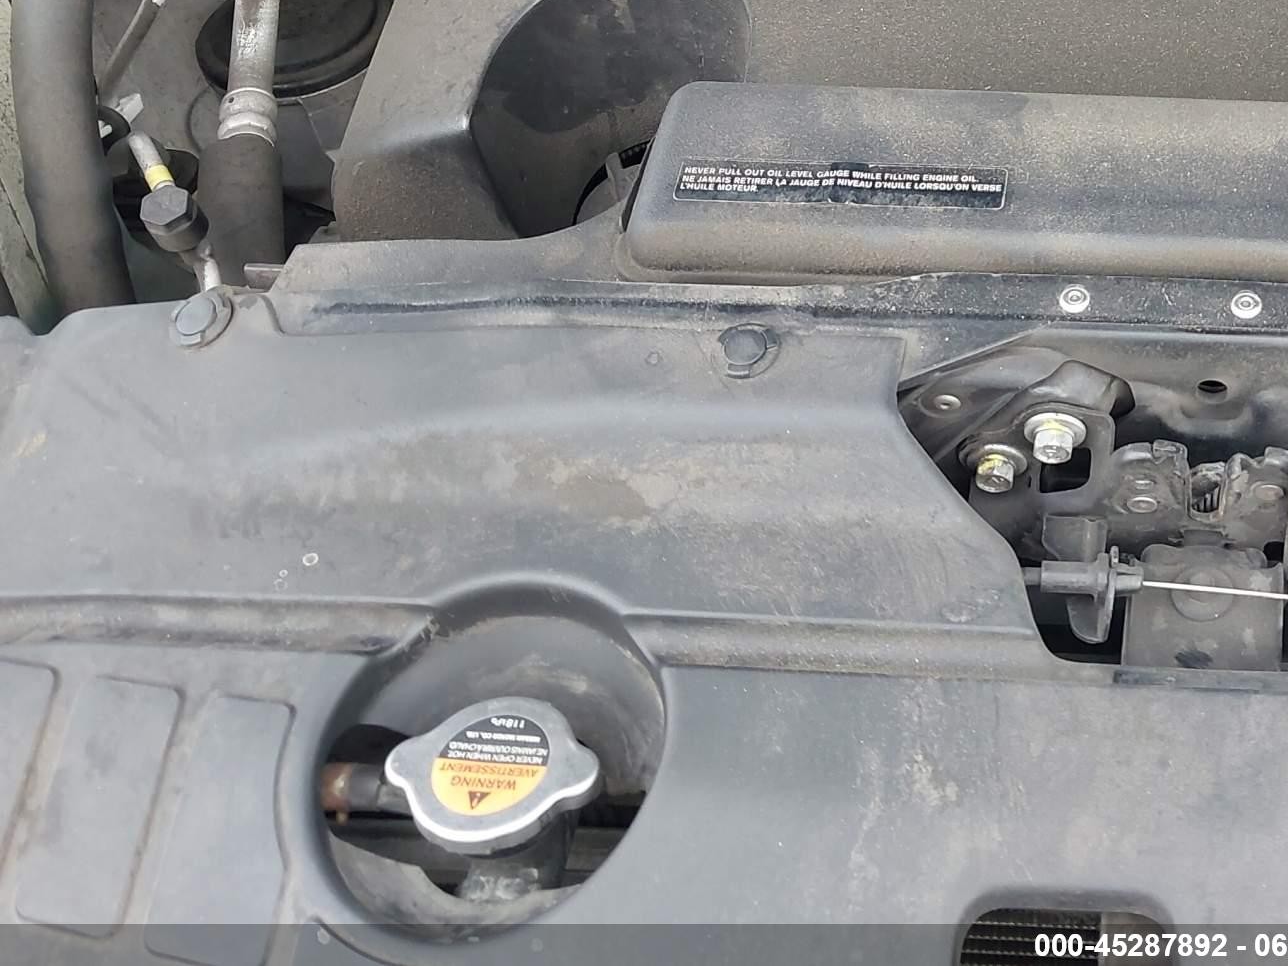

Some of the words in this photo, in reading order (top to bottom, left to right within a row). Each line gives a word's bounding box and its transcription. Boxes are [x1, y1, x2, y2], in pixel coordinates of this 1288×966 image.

[684, 166, 715, 175] NEVER
[767, 169, 783, 177] OIL
[852, 171, 882, 180] WHILE
[884, 172, 920, 181] FILLING
[923, 174, 959, 182] ENGINE
[734, 177, 773, 185] RETIRER
[836, 179, 873, 188] NIVEAU
[875, 181, 912, 190] D'HUILE
[914, 182, 969, 191] LORSQU'ON
[971, 184, 1003, 192] VERSE
[465, 751, 491, 760] WHEN
[492, 753, 515, 762] OPEN
[515, 755, 543, 764] NEVER
[439, 763, 540, 778] AVERTISSEMENT
[451, 775, 516, 790] WARNING
